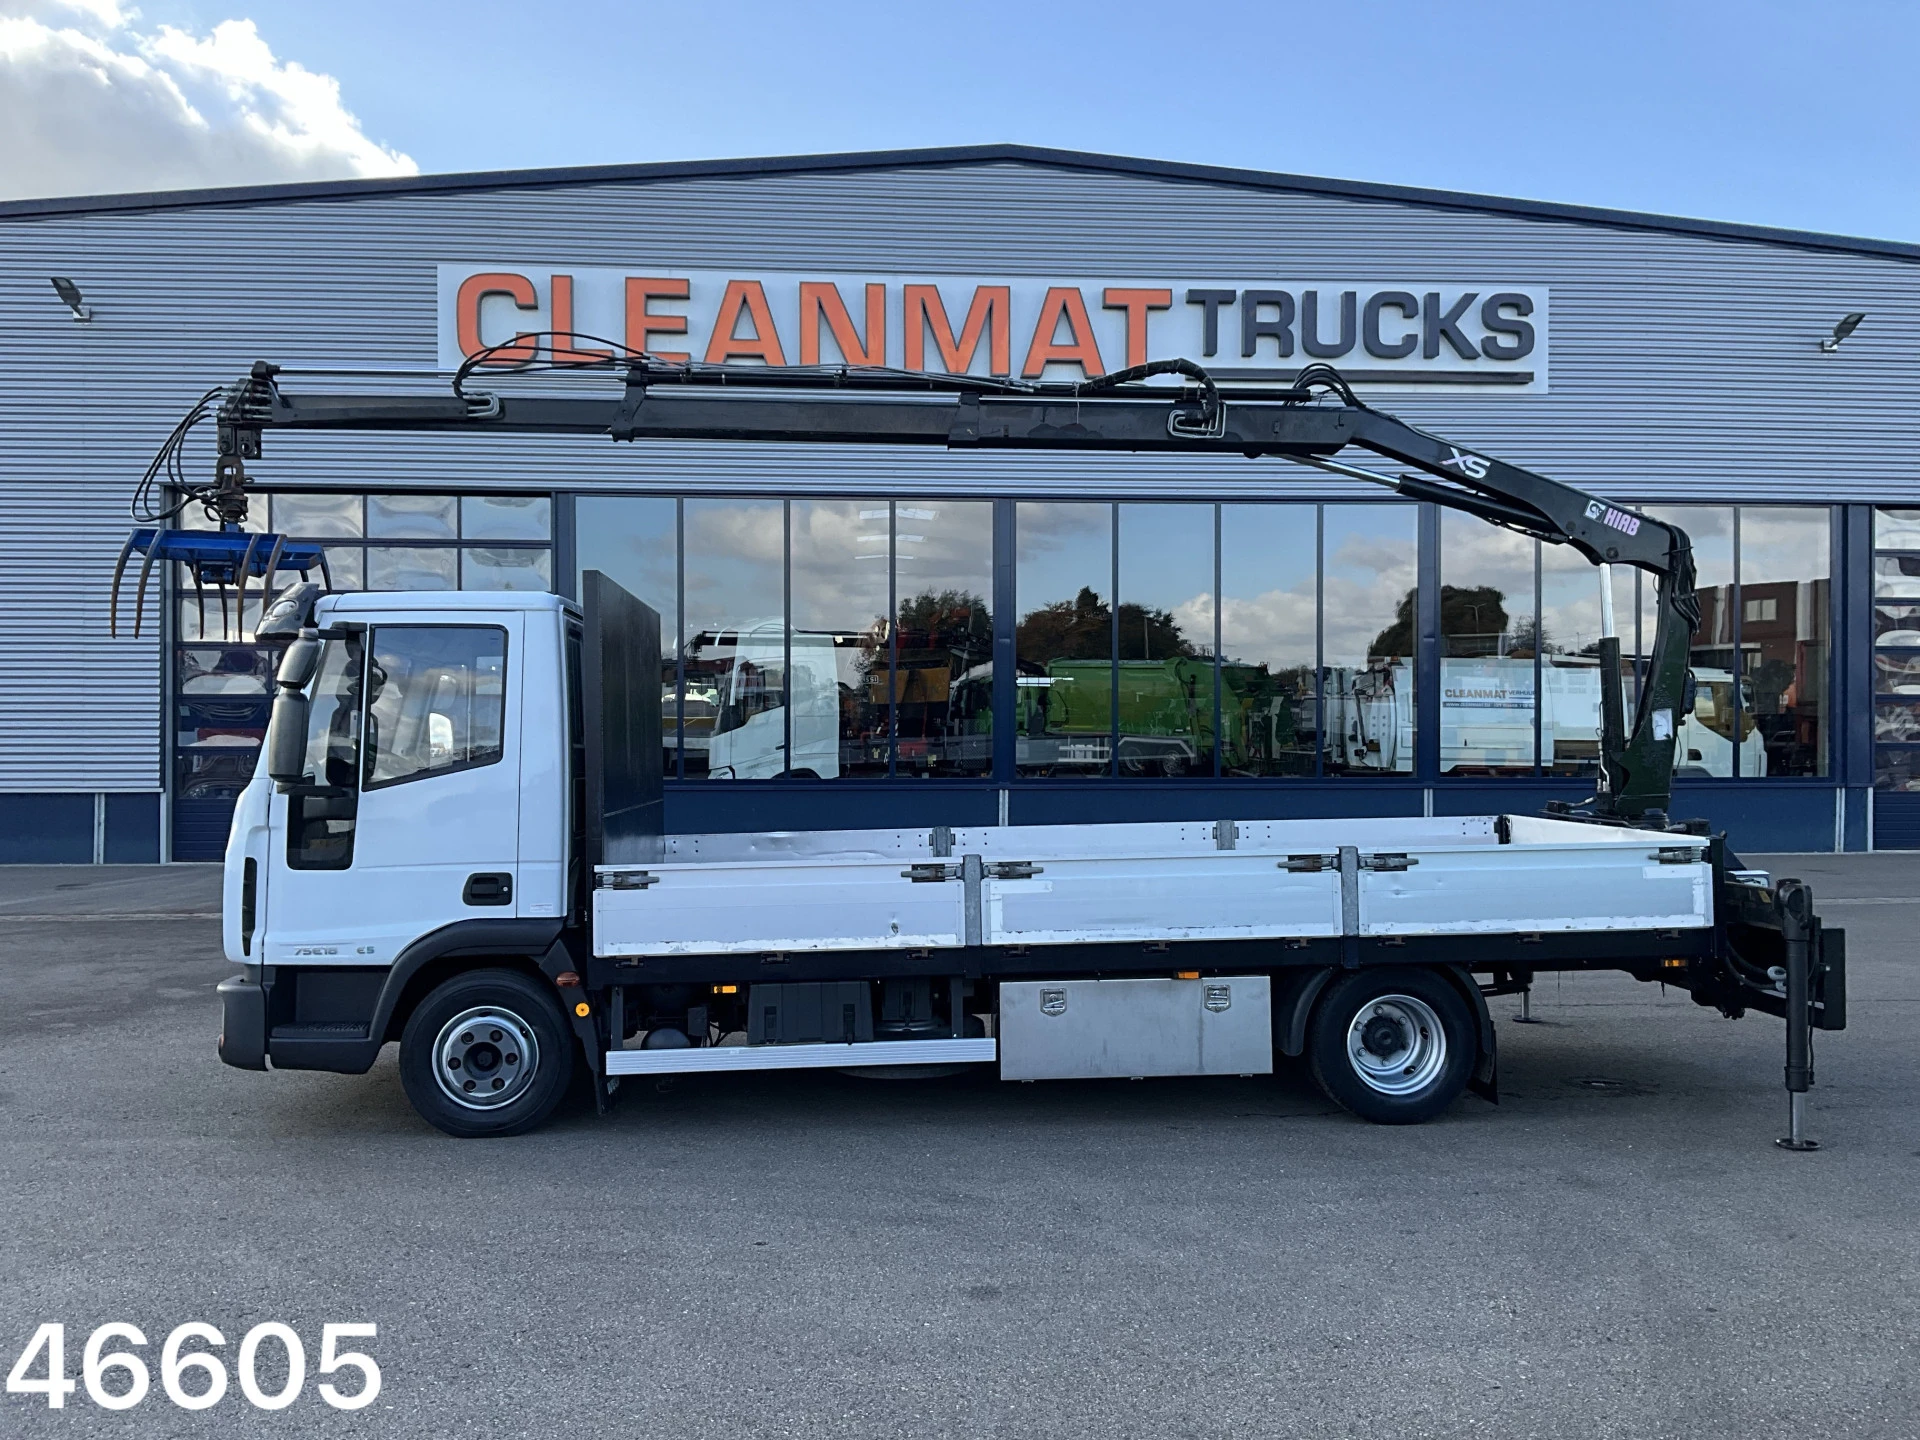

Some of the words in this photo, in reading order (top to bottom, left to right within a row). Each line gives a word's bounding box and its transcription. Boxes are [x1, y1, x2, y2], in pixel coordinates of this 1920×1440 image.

[456, 273, 1172, 378] CLEANMAT
[1185, 288, 1535, 361] TRUCKS
[1440, 447, 1491, 479] XS
[1603, 507, 1641, 536] HIAB
[1444, 688, 1507, 699] CLEANMAT
